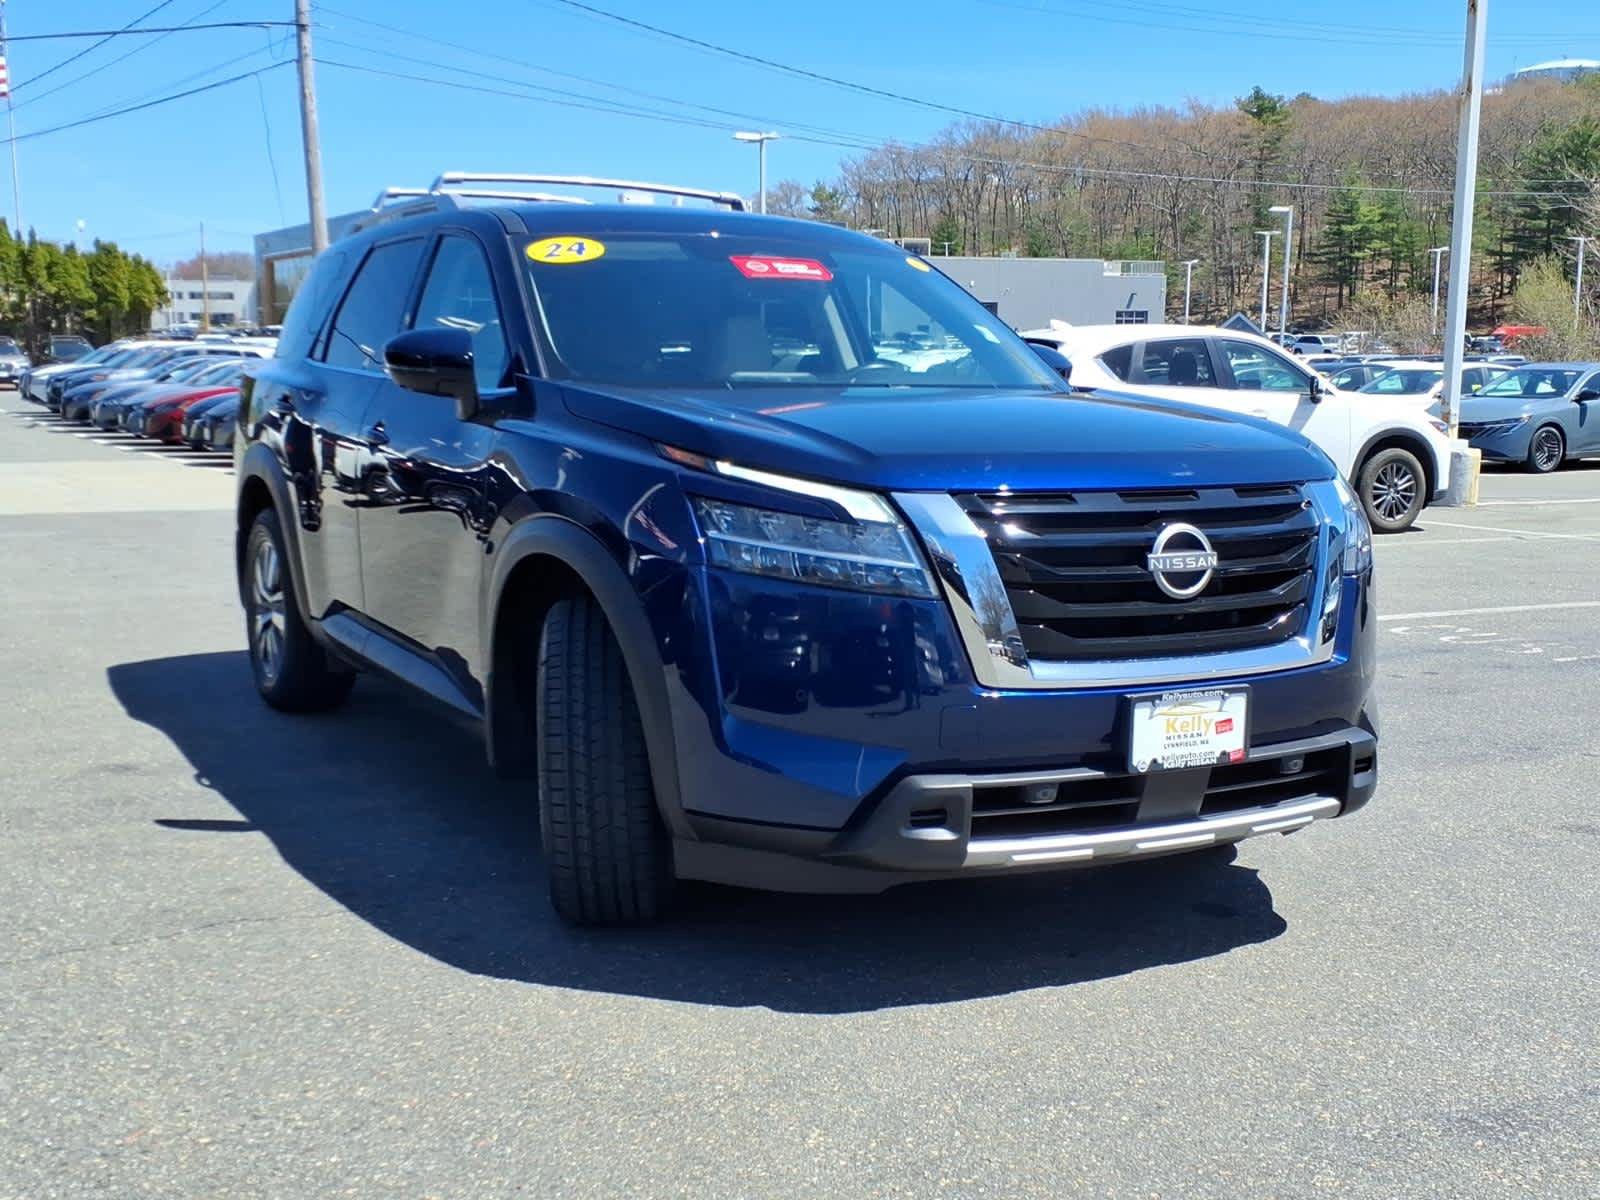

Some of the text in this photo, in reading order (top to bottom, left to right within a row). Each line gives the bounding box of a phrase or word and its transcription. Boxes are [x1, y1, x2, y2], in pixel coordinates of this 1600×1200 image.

[544, 242, 585, 257] 24
[1150, 556, 1217, 569] NISSAN
[1165, 715, 1213, 736] Kelly
[1165, 732, 1203, 741] NISSAN
[1161, 750, 1216, 762] kellyauto.com
[1162, 759, 1186, 769] Kelly
